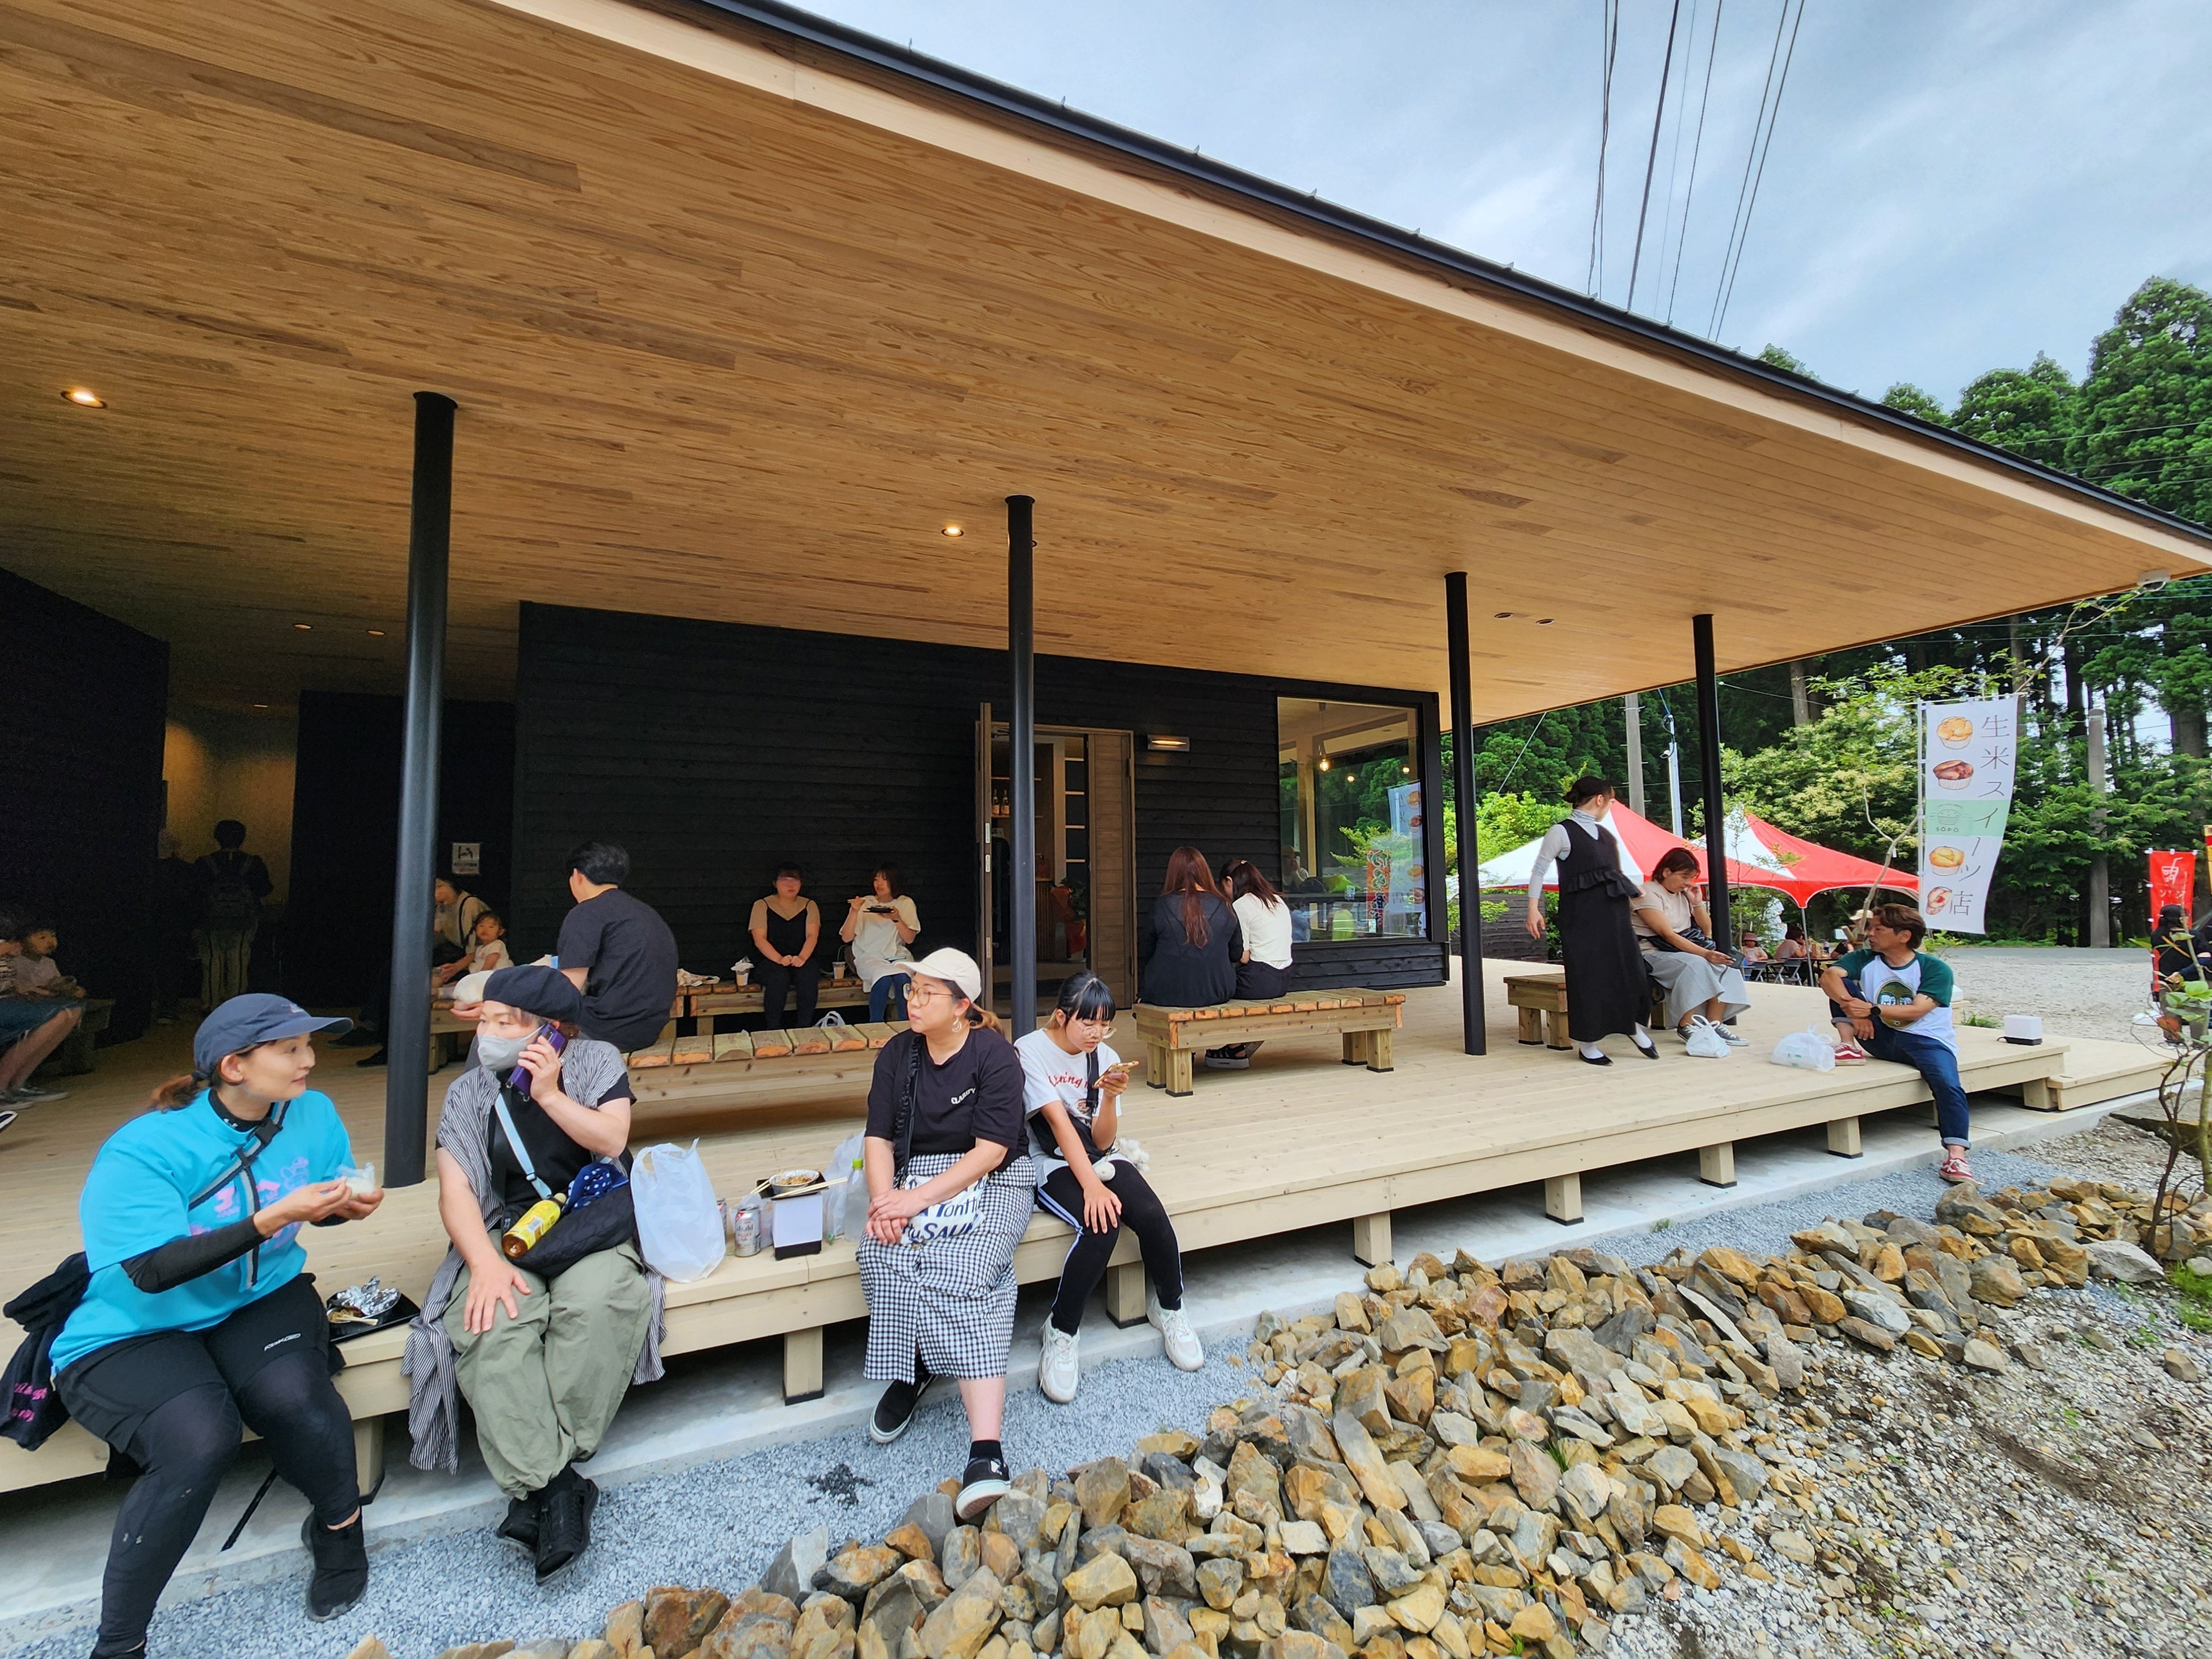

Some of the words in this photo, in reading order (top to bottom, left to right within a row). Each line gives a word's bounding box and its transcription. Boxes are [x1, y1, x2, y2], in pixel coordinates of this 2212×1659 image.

[1949, 714, 2010, 916] 生米スイーツ店
[951, 1087, 976, 1104] CLARIFY
